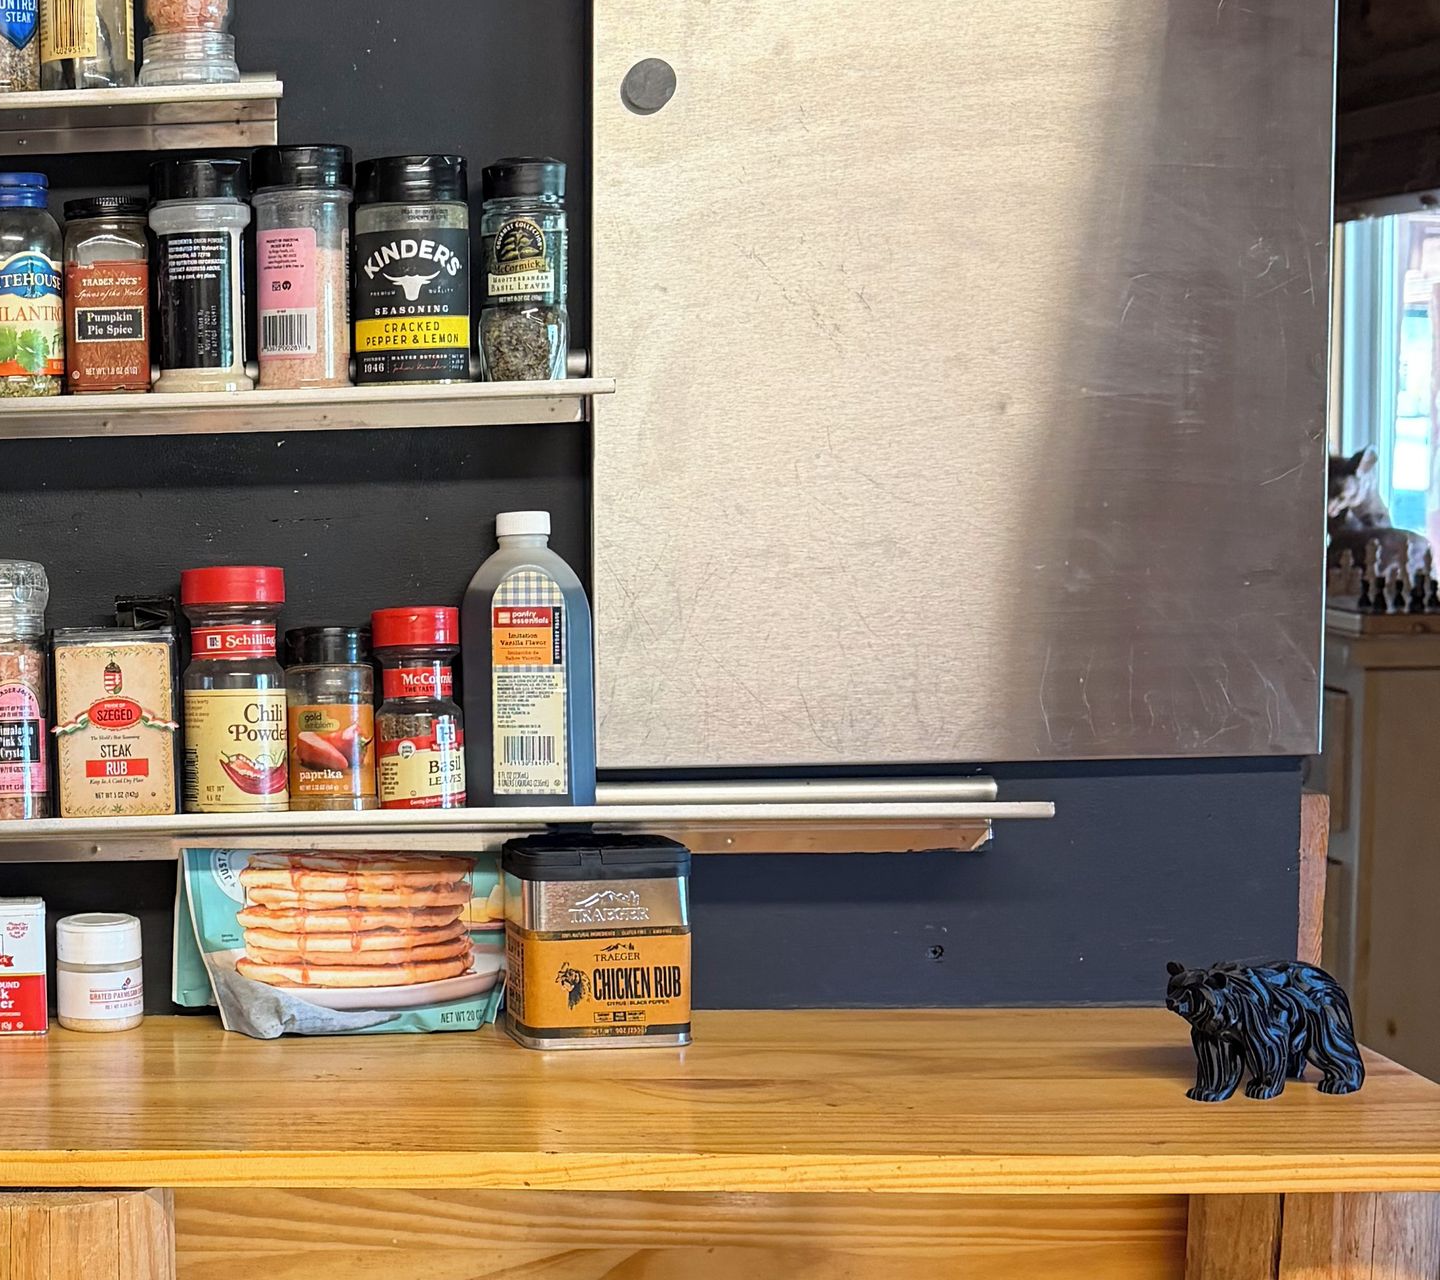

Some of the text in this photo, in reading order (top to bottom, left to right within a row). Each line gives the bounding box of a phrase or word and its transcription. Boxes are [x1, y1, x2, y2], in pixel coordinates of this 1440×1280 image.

[364, 239, 462, 279] KINDER'S
[82, 276, 138, 287] TRADER JOE'S
[493, 275, 549, 283] MEDITERRANEAN
[491, 282, 550, 292] BASIL LEAVES
[374, 305, 449, 316] SEASONING
[87, 312, 133, 324] Pumpkin
[88, 325, 133, 336] Pie Spice
[384, 322, 440, 333] CRACKED
[366, 333, 459, 346] PEPPER & LEMON
[85, 367, 95, 376] NET
[364, 363, 385, 373] 1946
[512, 611, 536, 619] pantry
[225, 633, 276, 648] Schilling
[96, 710, 133, 721] SZEGED
[243, 703, 283, 724] Chili
[304, 712, 323, 723] gold
[304, 720, 335, 730] emblem
[100, 744, 132, 758] STEAK
[105, 761, 128, 775] RUB
[299, 769, 344, 781] paprika
[124, 777, 133, 785] Dry
[206, 784, 226, 793] NET WT
[118, 791, 125, 799] OZ
[218, 858, 232, 880] JUST
[593, 952, 640, 963] TRAEGER
[593, 966, 681, 1001] CHICKEN RUB
[90, 993, 113, 1001] GRATED
[440, 1011, 475, 1024] NET WT 20
